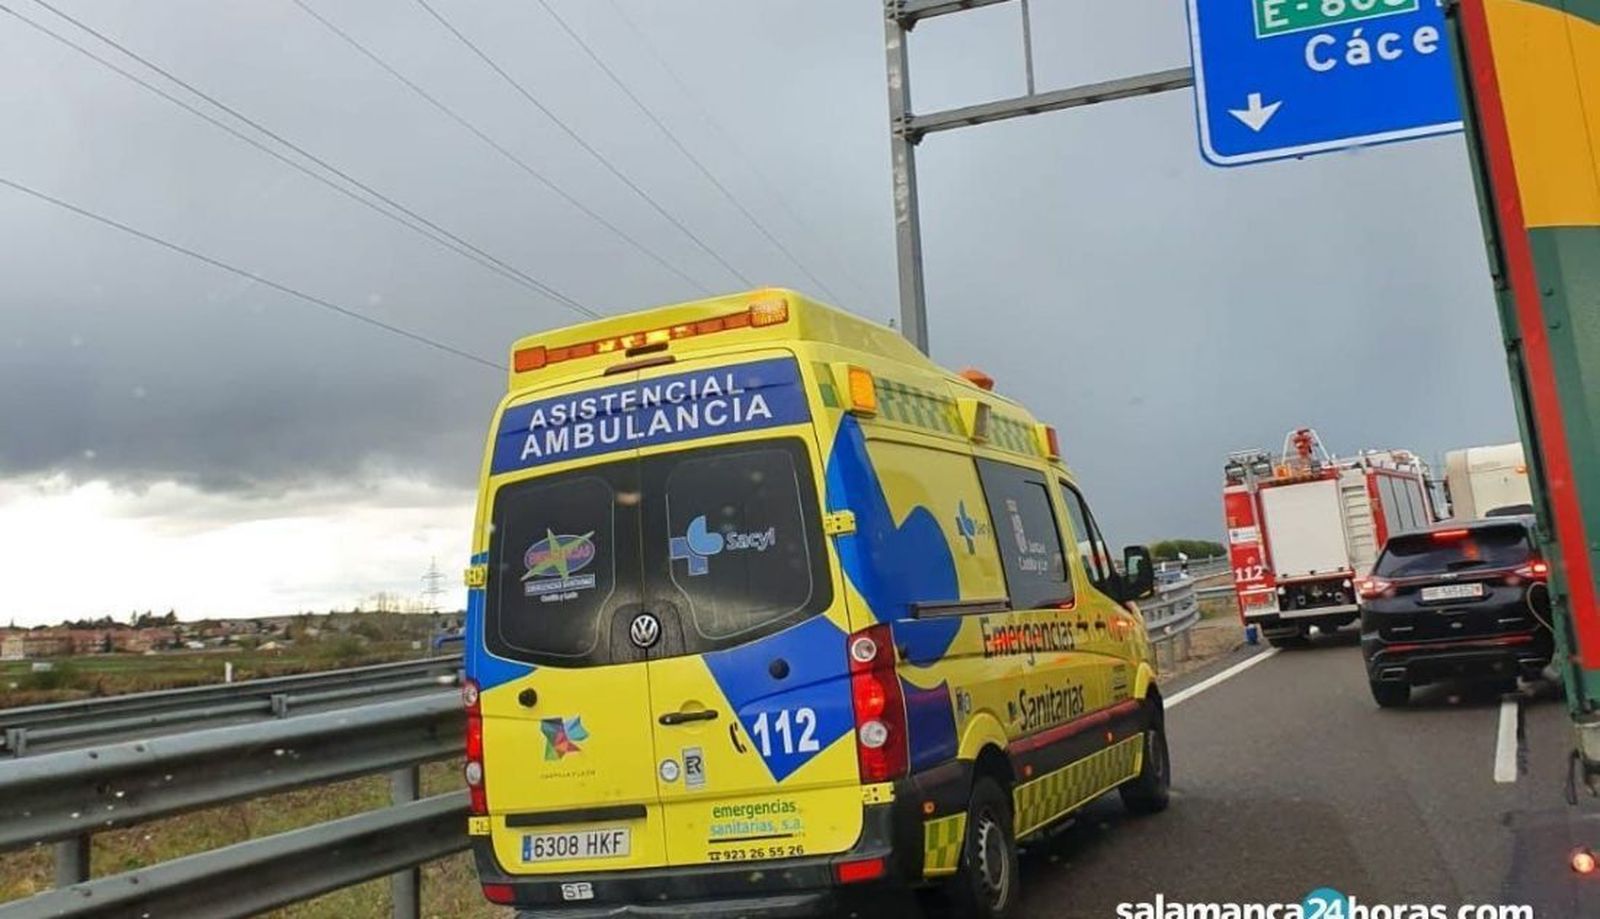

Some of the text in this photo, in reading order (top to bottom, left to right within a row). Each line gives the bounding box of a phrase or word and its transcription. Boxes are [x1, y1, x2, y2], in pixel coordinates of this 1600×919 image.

[529, 373, 745, 432] ASISTENCIAL
[520, 394, 773, 460] AMBULANCIA
[726, 527, 775, 551] Sacyl
[1235, 565, 1264, 582] 112
[980, 613, 1075, 666] Emergencias
[1019, 678, 1084, 731] Sanitarias
[754, 708, 819, 756] 112
[713, 799, 796, 819] emergencias
[534, 832, 624, 858] 6308 HKF
[723, 843, 804, 860] 923 26 55 26
[563, 884, 590, 899] SP
